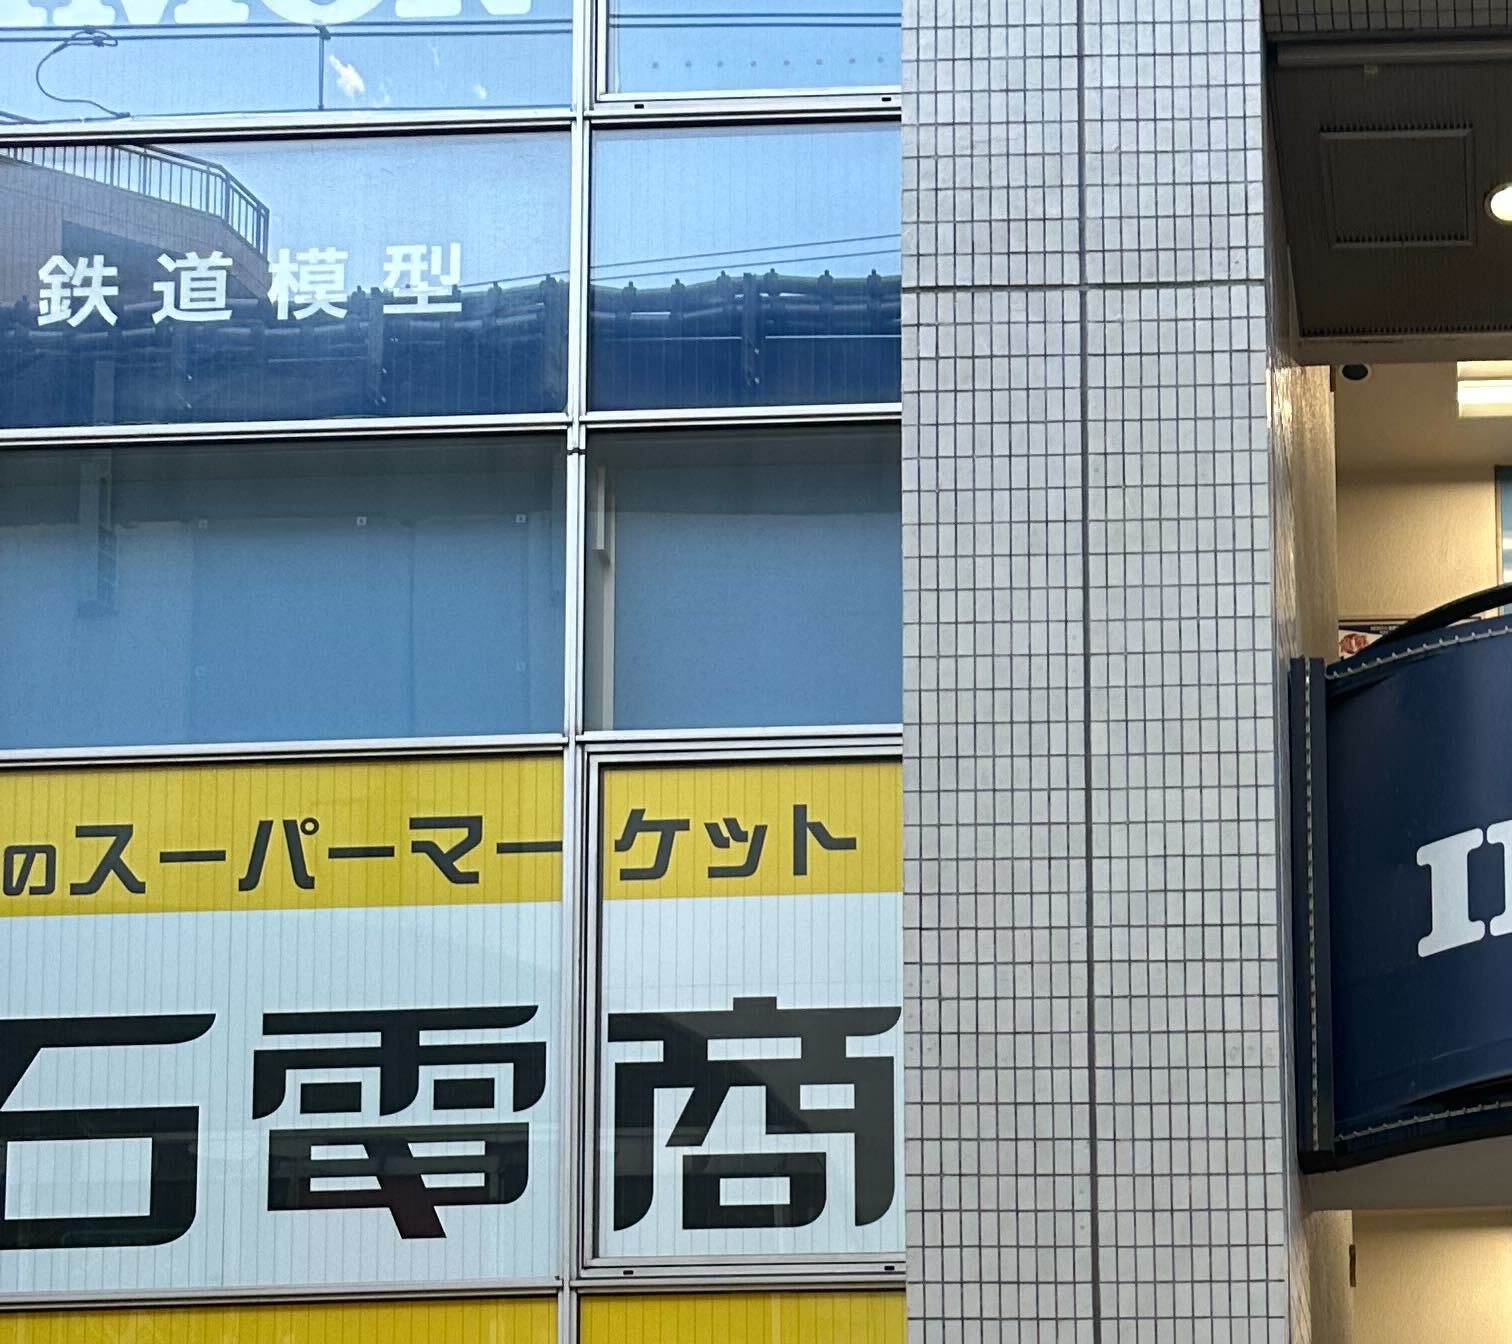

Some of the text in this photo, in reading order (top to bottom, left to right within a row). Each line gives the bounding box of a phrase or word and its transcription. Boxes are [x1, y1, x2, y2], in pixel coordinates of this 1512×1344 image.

[37, 243, 464, 328] 鉄道模型
[2, 804, 857, 897] のスーパーマーケット
[0, 997, 903, 1251] 石電商
